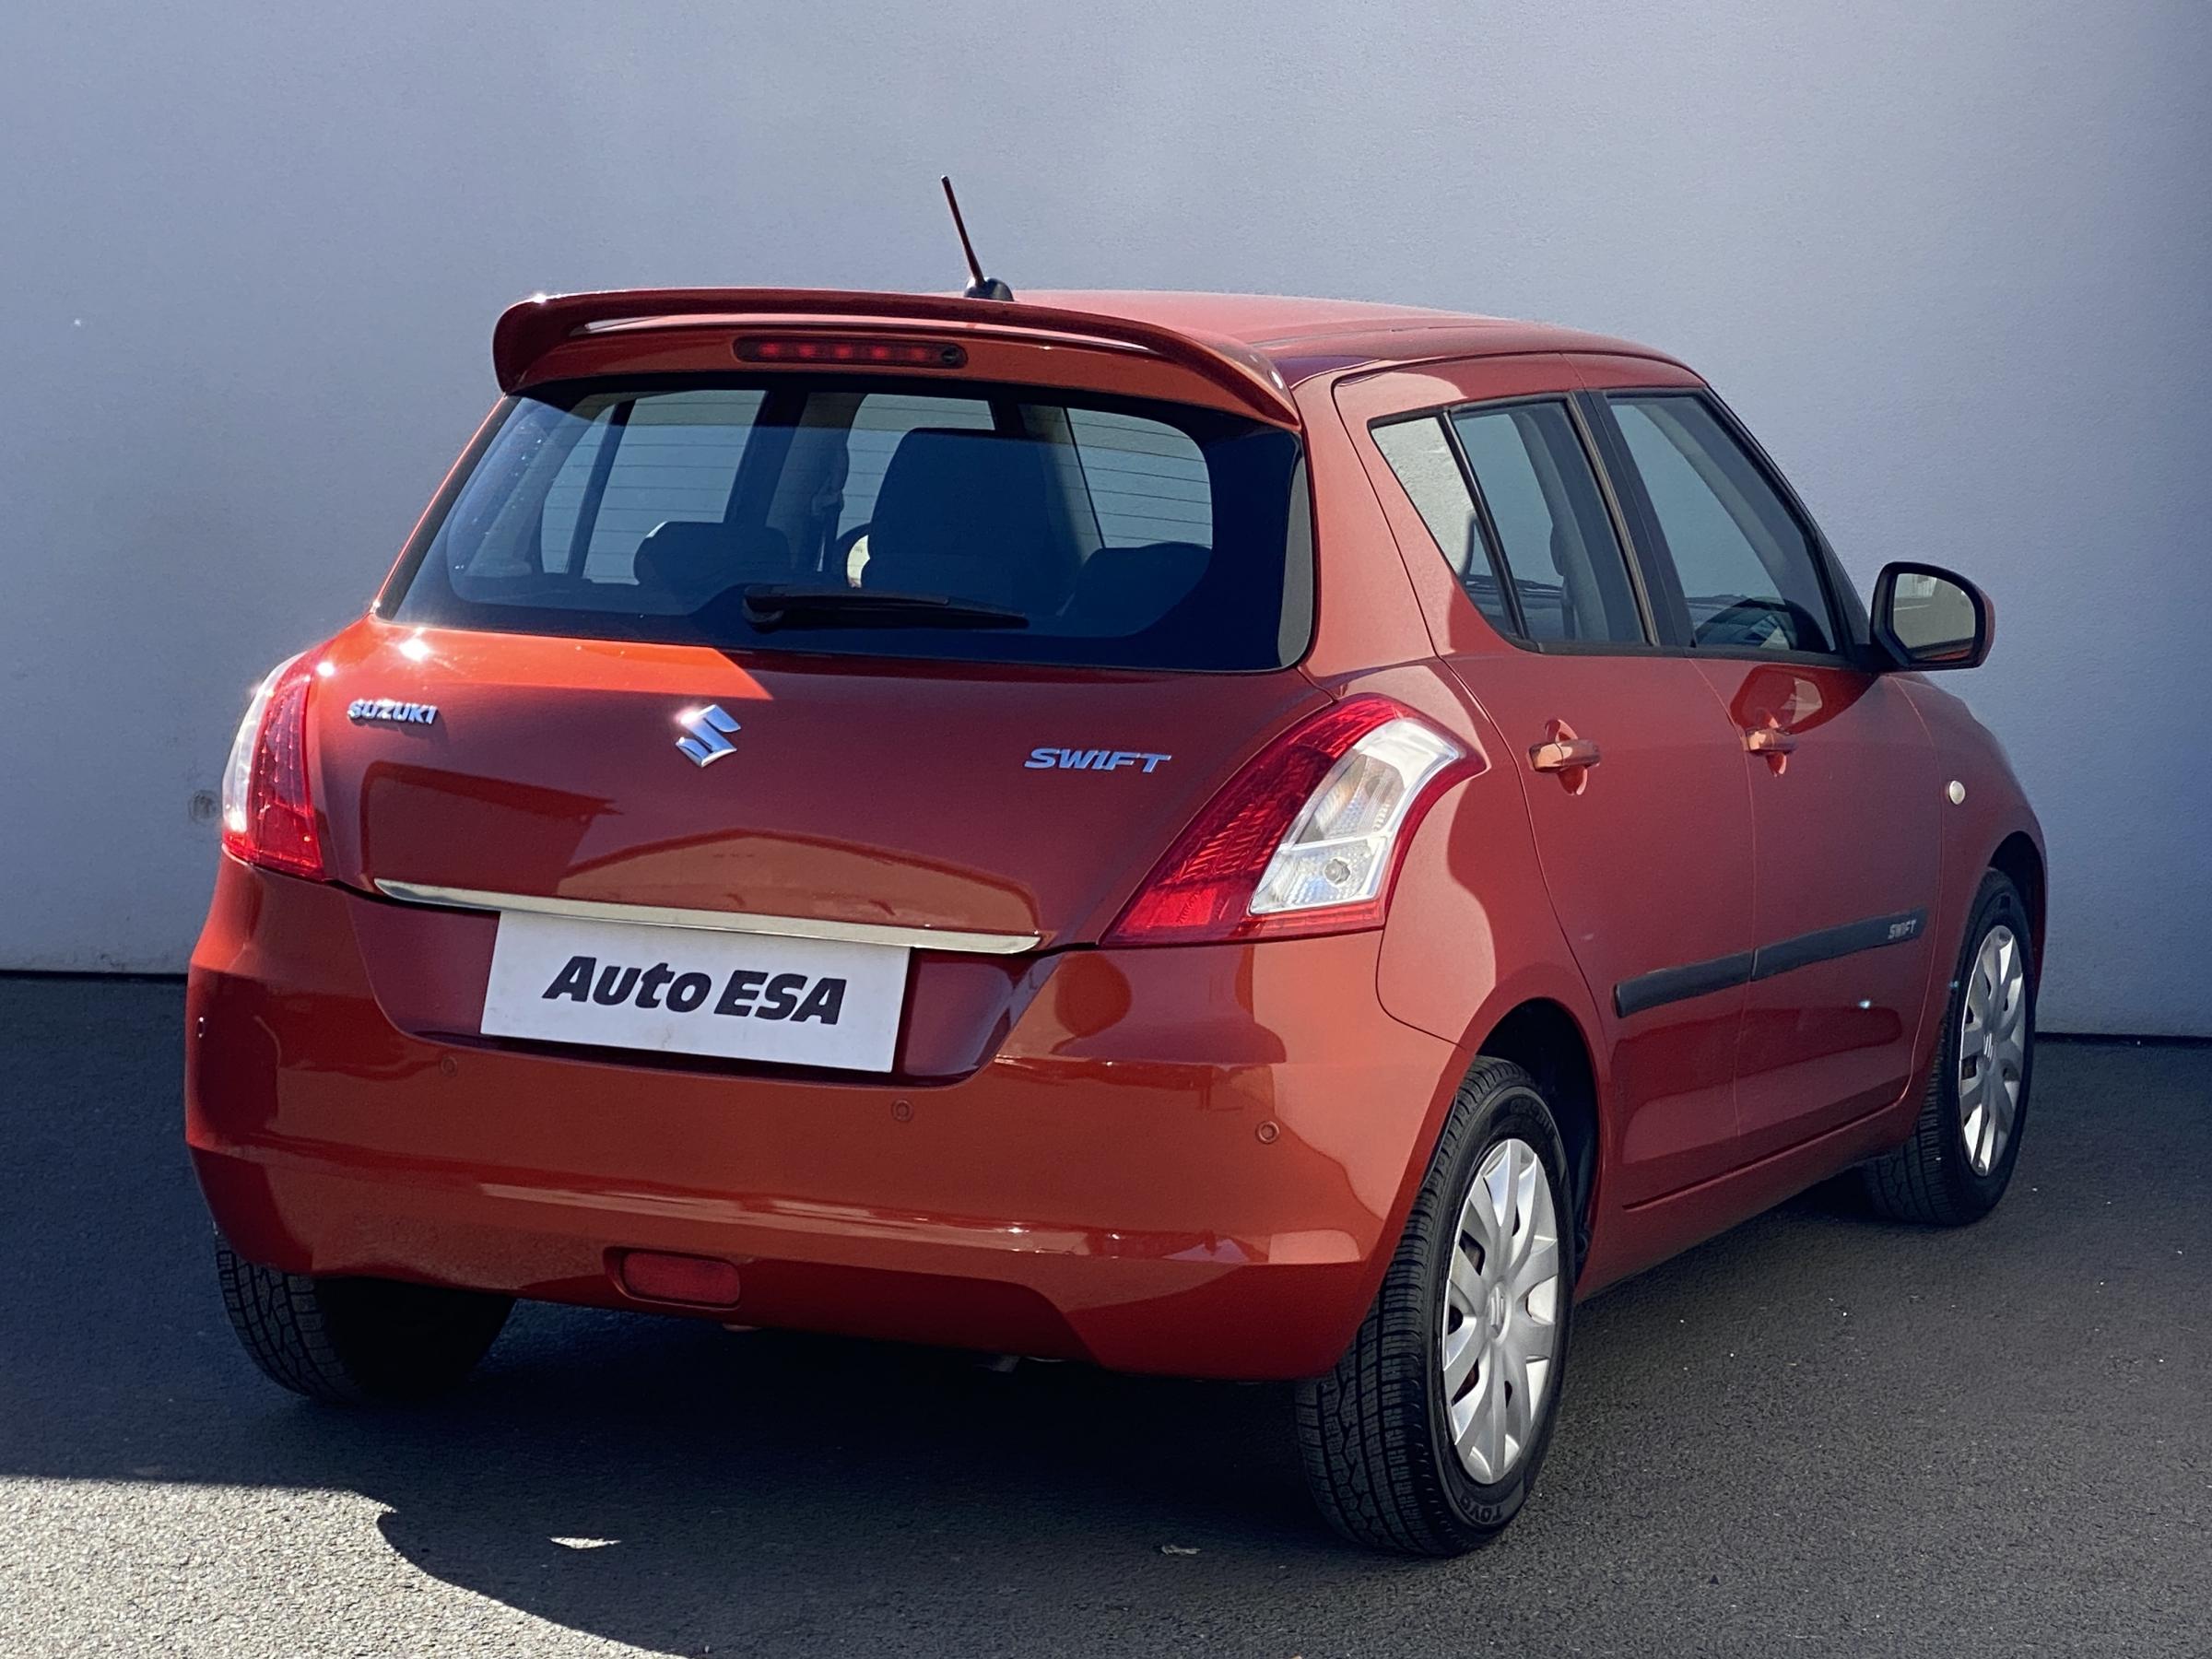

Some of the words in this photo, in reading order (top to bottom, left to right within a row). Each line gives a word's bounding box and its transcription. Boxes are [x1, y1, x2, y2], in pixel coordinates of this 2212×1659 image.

[347, 699, 438, 724] SUZUKI
[1024, 747, 1171, 773] SWIFT
[542, 956, 712, 1013] Auto
[713, 970, 847, 1025] ESA
[1460, 1495, 1502, 1524] TOYO
